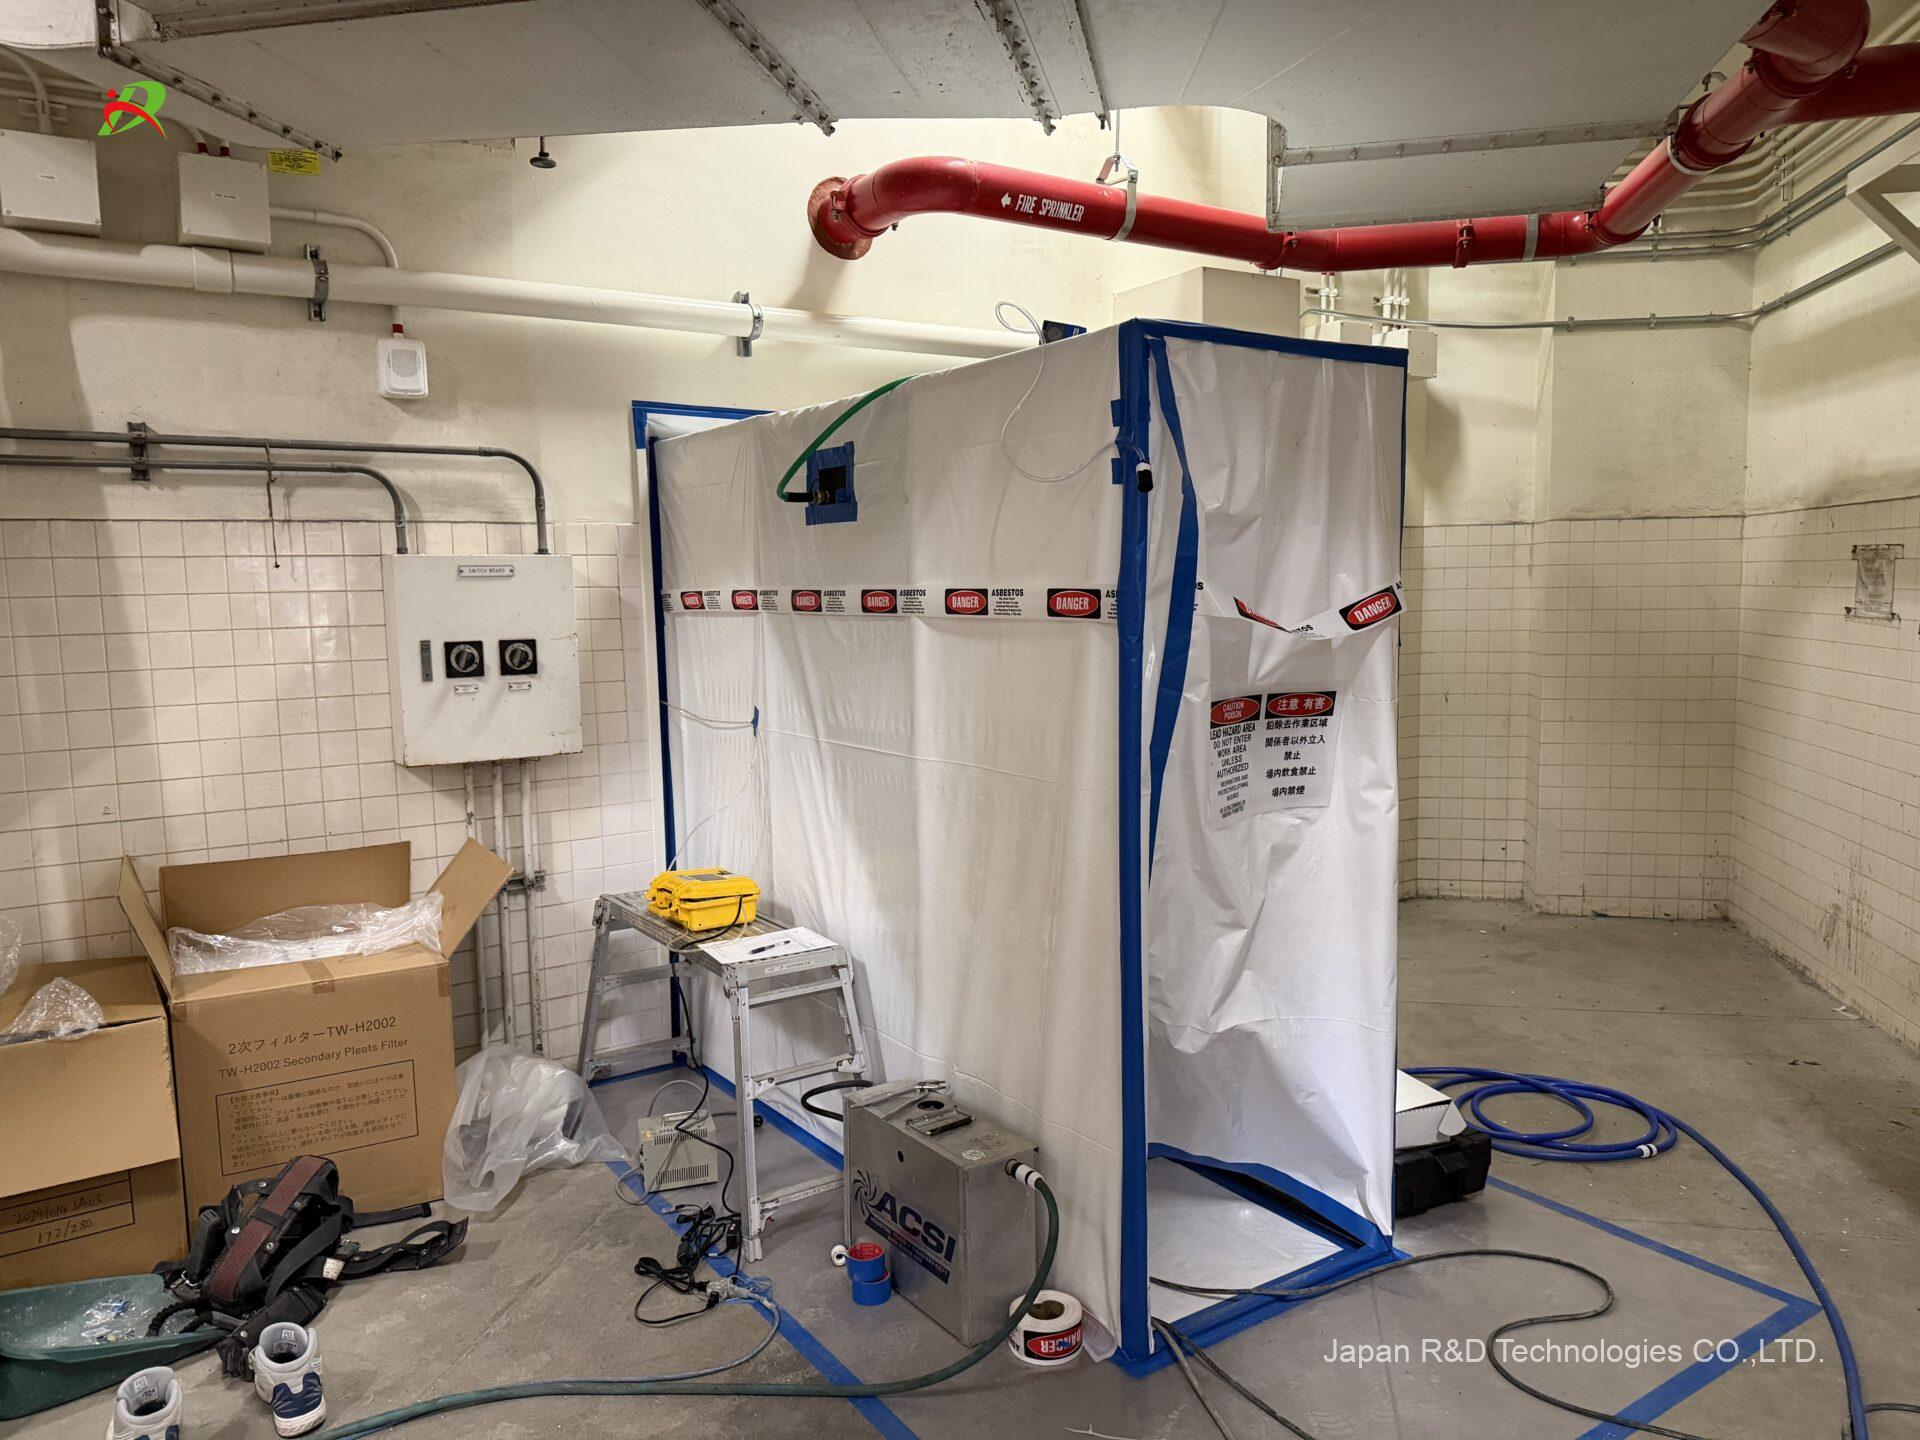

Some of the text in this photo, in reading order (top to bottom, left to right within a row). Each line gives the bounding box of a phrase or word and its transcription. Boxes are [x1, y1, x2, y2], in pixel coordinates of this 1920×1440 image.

[1015, 194, 1085, 222] FIRE SPRINKLER
[735, 595, 753, 605] DANGER
[796, 595, 816, 606] DANGER
[867, 596, 889, 607] DANGER
[900, 589, 926, 597] ASBESTOS
[952, 596, 979, 608] DANGER
[991, 589, 1024, 597] ASBESTOS
[1056, 597, 1090, 610] DANGER
[1354, 596, 1391, 622] DANGER
[1222, 701, 1245, 712] CAUTION
[1278, 697, 1326, 711] 注意 有害
[1223, 710, 1242, 720] POISON
[1210, 722, 1256, 740] LEAD HAZARD AREA
[1266, 718, 1328, 731] 鉛除去作業区域
[1213, 733, 1252, 749] DO NOT ENTER
[1264, 734, 1326, 748] 関係者以外立入
[1217, 744, 1247, 758] WORK AREA
[1283, 750, 1301, 761] 禁止
[1221, 755, 1243, 767] UNLESS
[1216, 763, 1249, 779] AUTHORIZED
[1265, 766, 1317, 780] 場内飲食禁止
[1271, 785, 1305, 798] 場内禁煙
[228, 1016, 396, 1055] 2次フィルターTW-H2002
[218, 1039, 408, 1079] TW-H2002 Secondary Pleats Filter
[872, 1191, 956, 1264] ACSI
